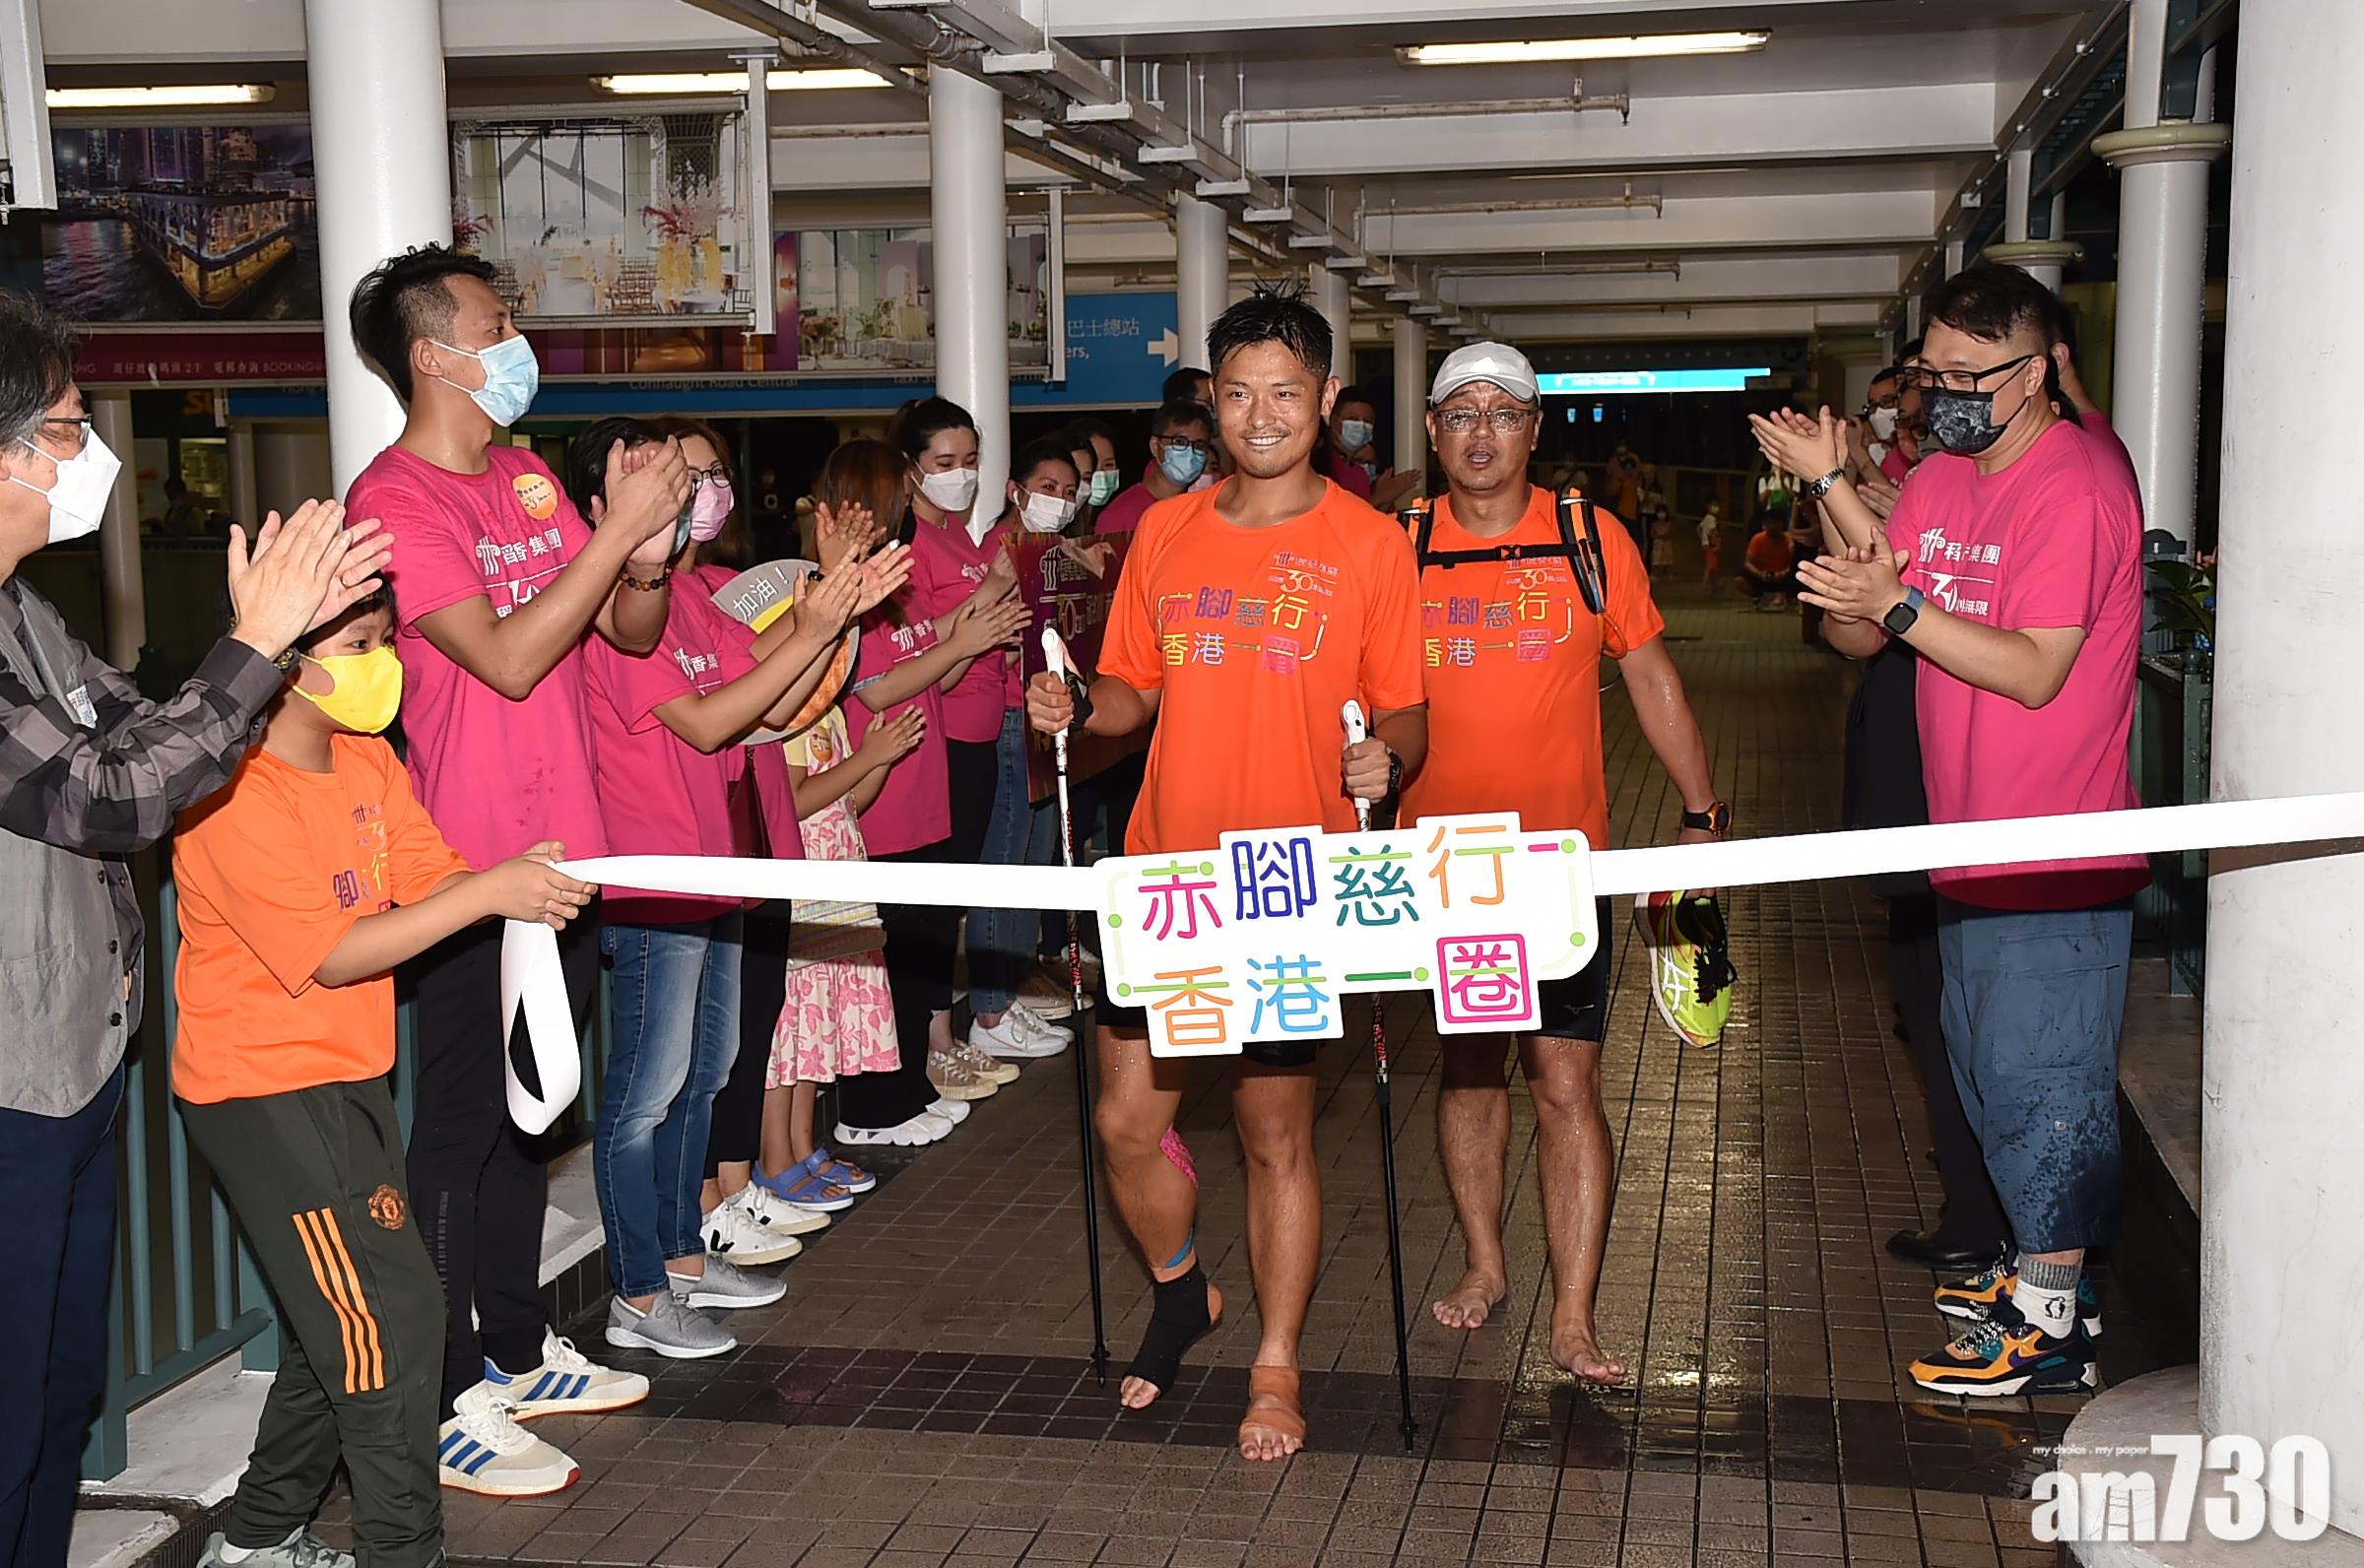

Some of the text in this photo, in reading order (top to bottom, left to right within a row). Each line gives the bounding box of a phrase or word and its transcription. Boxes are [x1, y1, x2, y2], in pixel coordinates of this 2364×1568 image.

[1068, 318, 1140, 338] 巴士總站
[1137, 824, 1515, 942] 赤腳慈行
[1151, 933, 1533, 1046] 香港一圈
